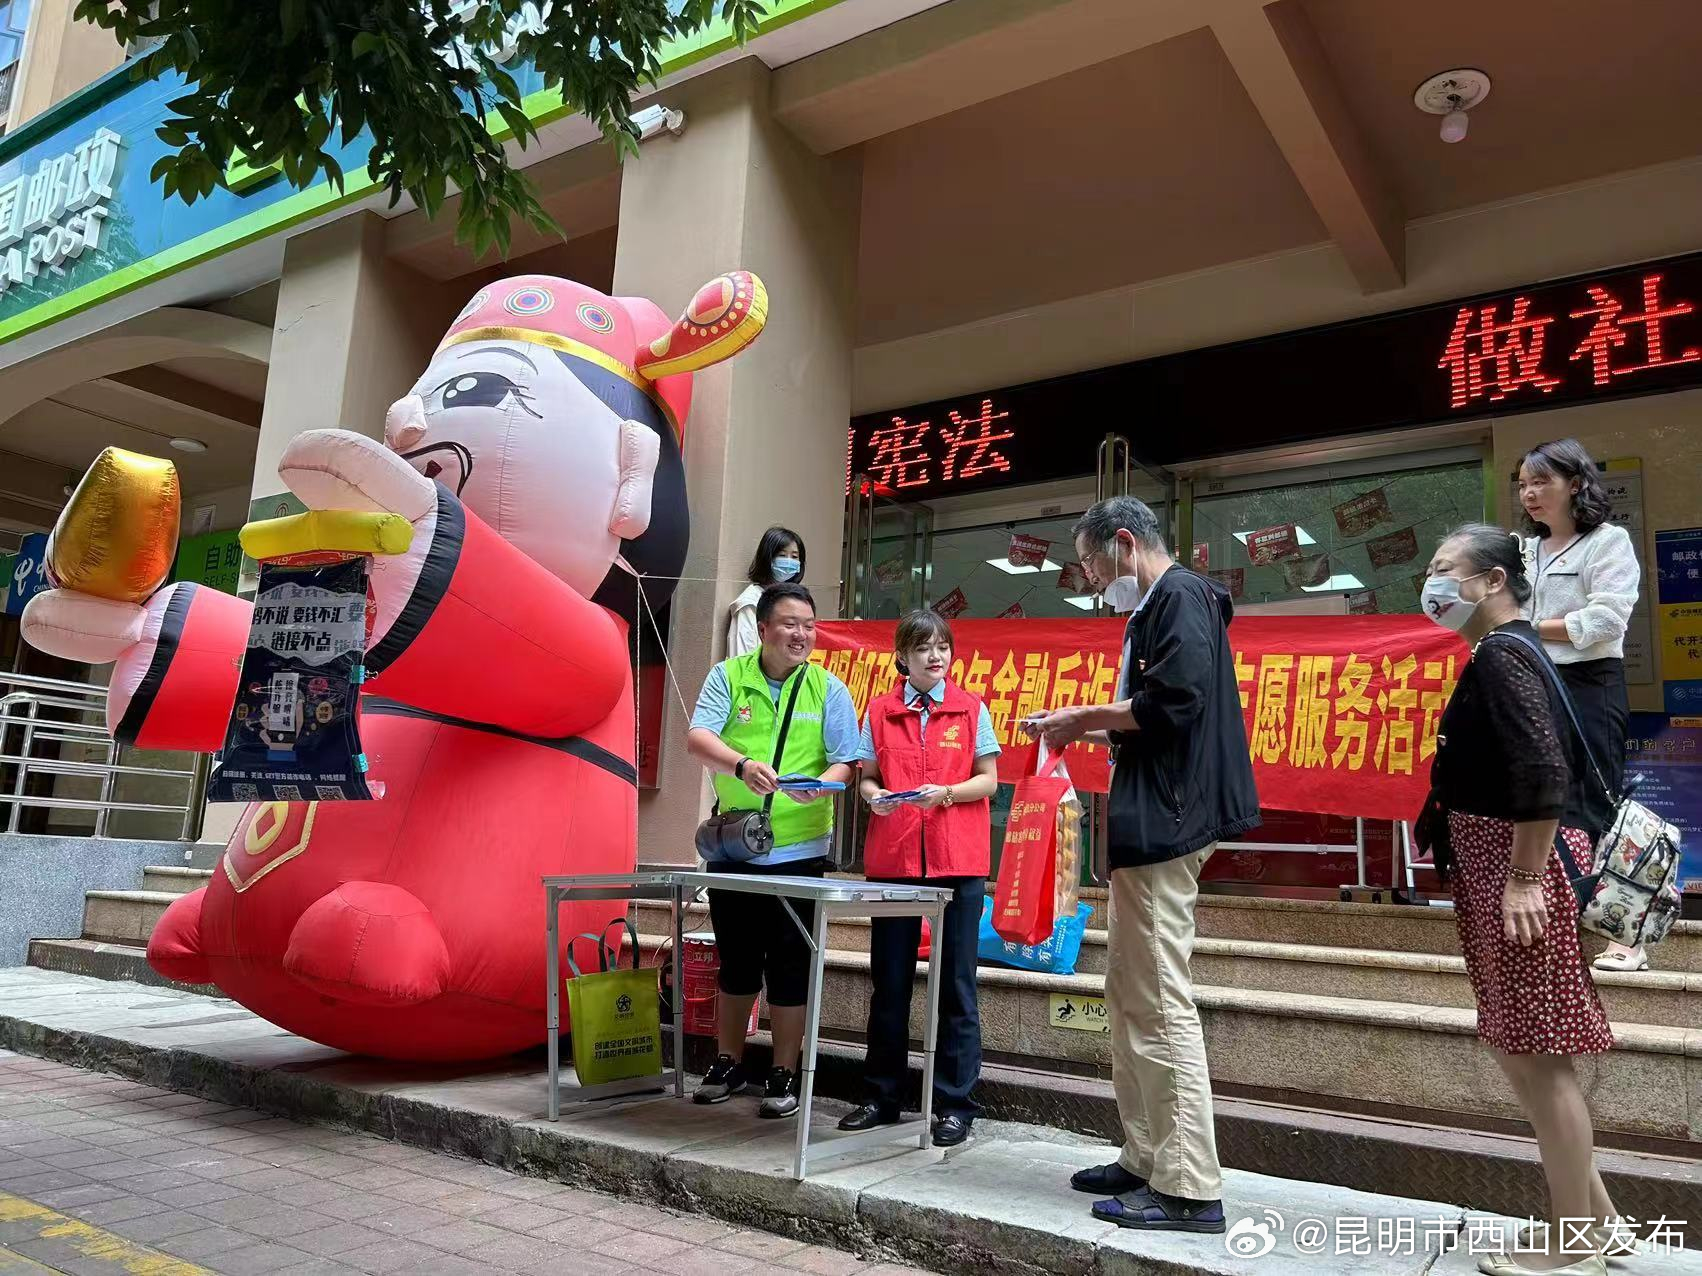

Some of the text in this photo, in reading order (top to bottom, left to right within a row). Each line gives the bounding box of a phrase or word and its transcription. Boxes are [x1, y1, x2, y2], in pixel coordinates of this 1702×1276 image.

[24, 204, 109, 278] POST
[1437, 275, 1702, 409] 做社
[846, 399, 1015, 494] 宪法
[205, 541, 242, 572] 自助
[293, 605, 346, 624] 要钱不汇
[271, 631, 332, 652] 链接不点
[1674, 635, 1702, 647] 代开
[1082, 1001, 1108, 1017] 小心
